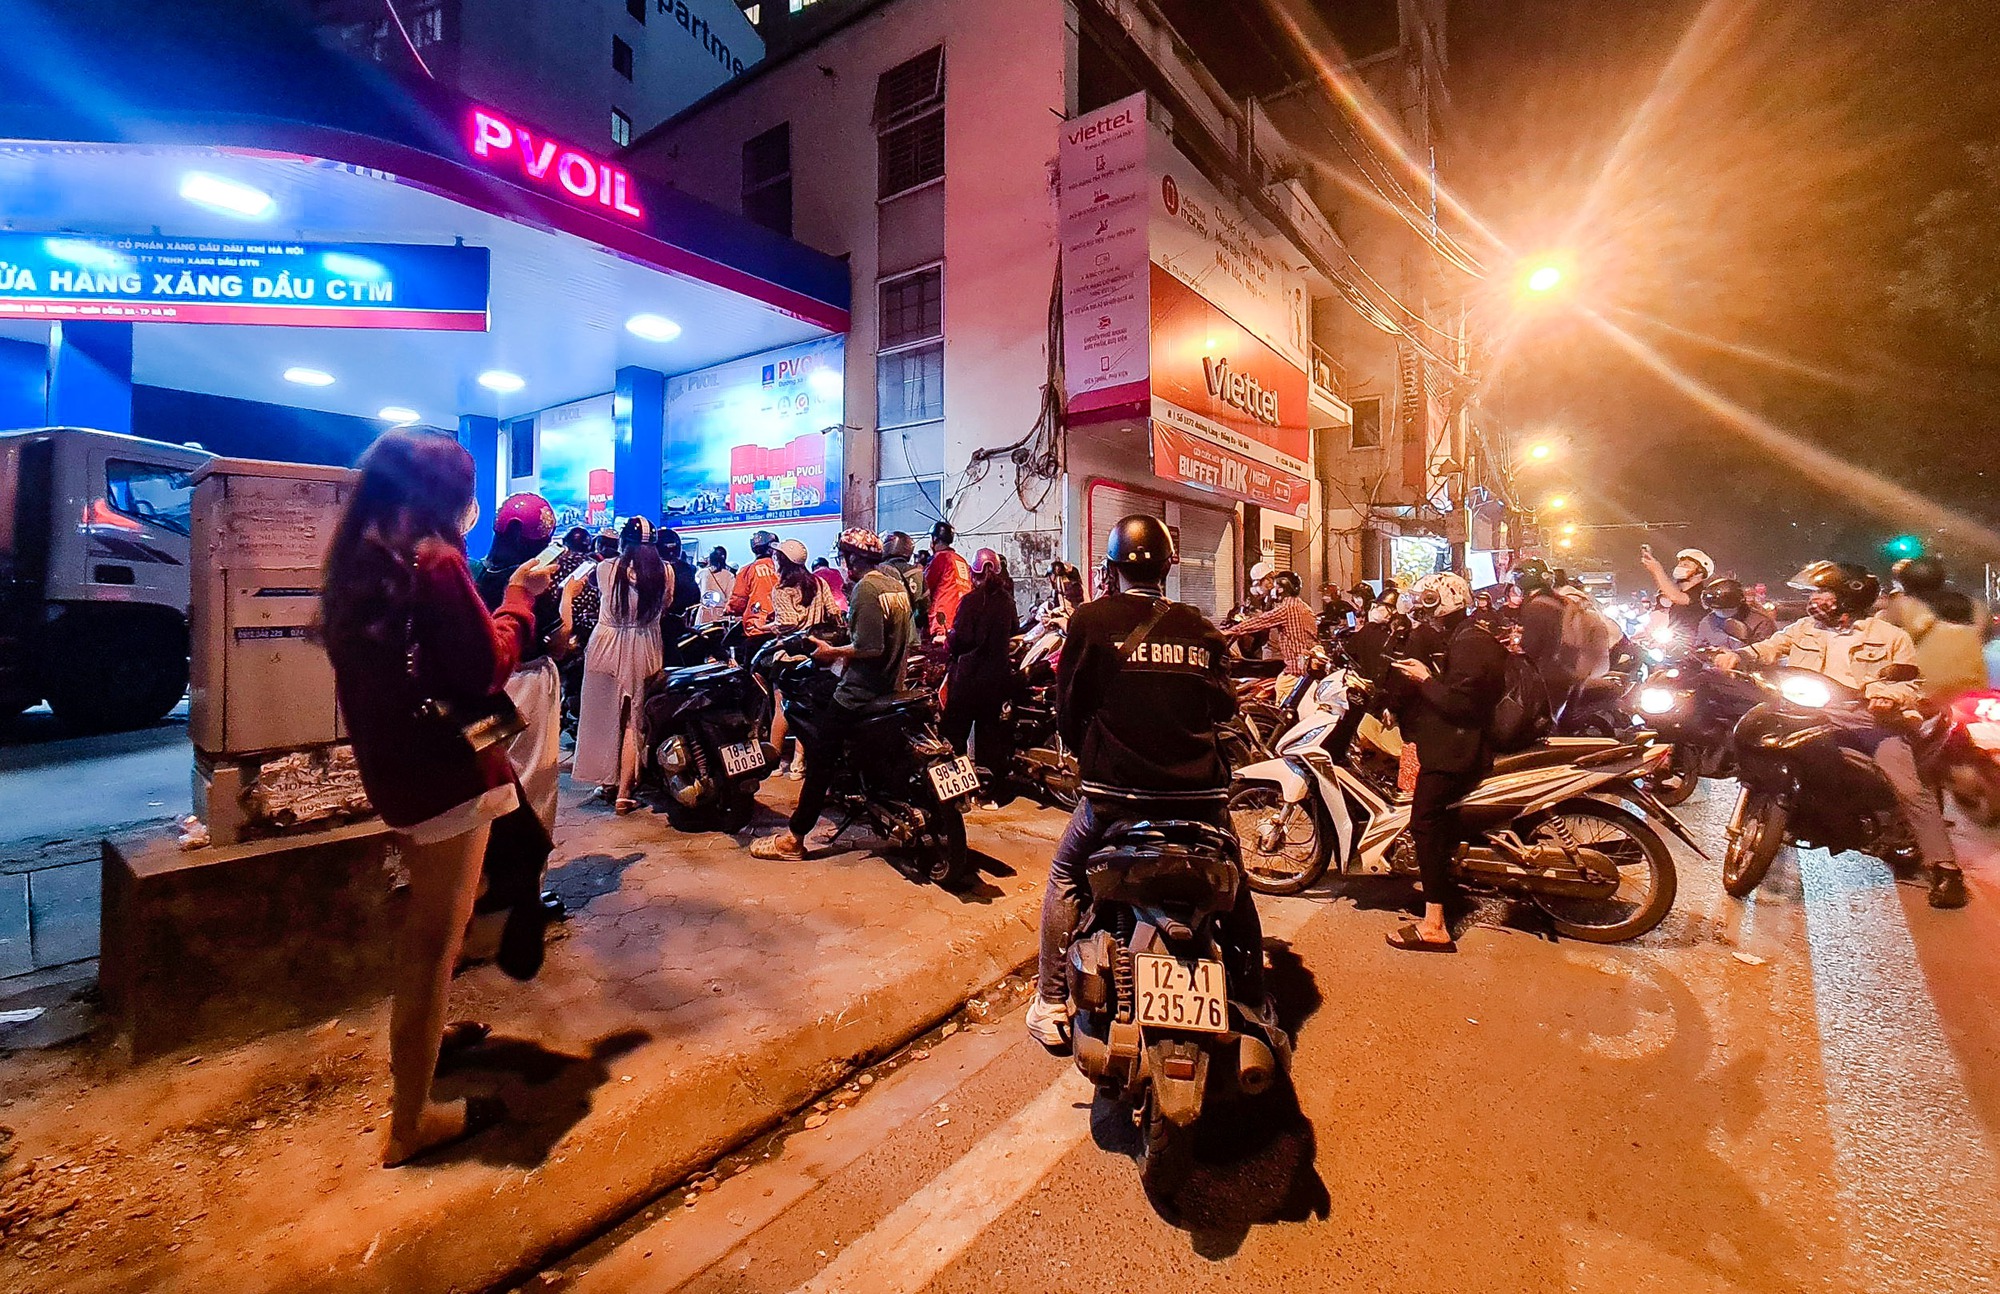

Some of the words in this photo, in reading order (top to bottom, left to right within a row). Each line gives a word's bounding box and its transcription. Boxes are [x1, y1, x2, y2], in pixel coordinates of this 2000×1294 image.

[473, 111, 641, 218] PVOIL
[1181, 206, 1209, 240] money
[152, 270, 244, 297] XĂNG
[252, 269, 315, 299] DẦU
[326, 279, 393, 301] CTM
[731, 473, 756, 485] PVOIL
[796, 464, 823, 477] PVOIL
[1178, 454, 1220, 486] BUFFET
[1220, 456, 1249, 494] 10K
[1150, 642, 1184, 664] BAD
[728, 752, 764, 774] 400.98
[939, 772, 977, 798] 146.09
[1150, 960, 1210, 993] 12-X1
[1142, 991, 1222, 1027] 235.76
